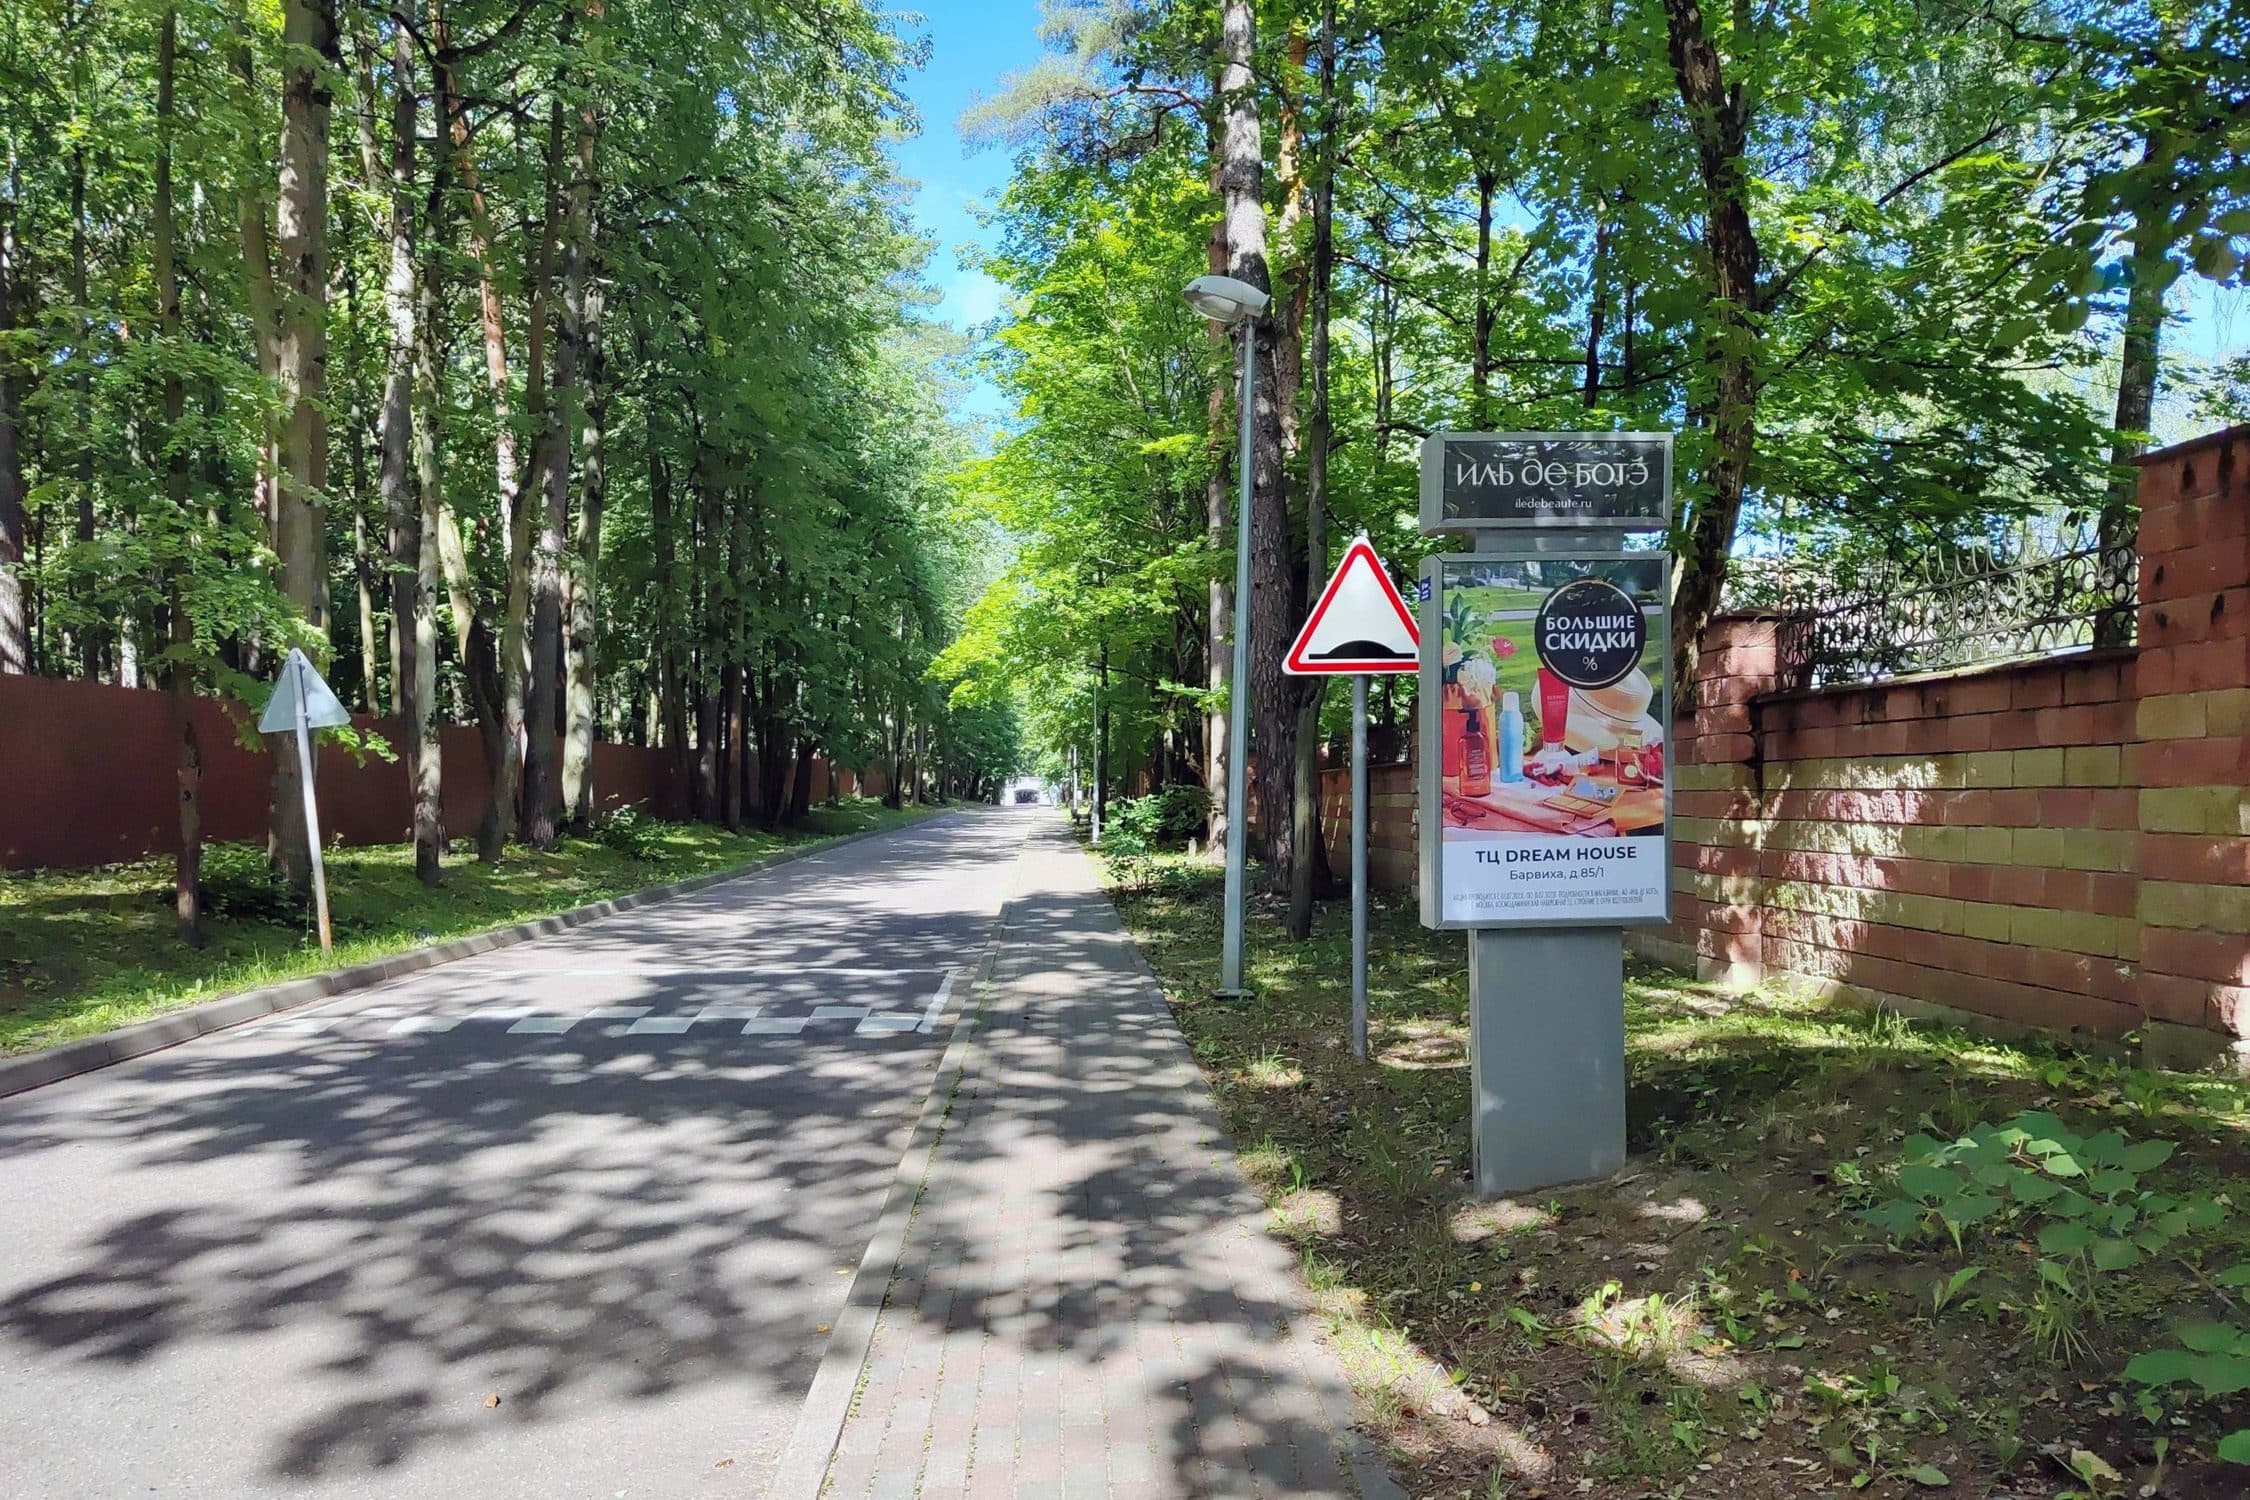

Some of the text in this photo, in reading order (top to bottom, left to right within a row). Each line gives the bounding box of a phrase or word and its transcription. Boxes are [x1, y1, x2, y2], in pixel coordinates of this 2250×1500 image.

[1457, 463, 1514, 486] ИЛЬ
[1576, 462, 1648, 487] БОТЭ
[1515, 498, 1592, 509] iledebeaute.ru
[1546, 615, 1635, 631] БОЛЬШИЕ
[1545, 631, 1636, 652] СКИДКИ
[1582, 656, 1598, 671] %
[1475, 846, 1637, 864] ТЦ DREAM HOUSE
[1510, 869, 1567, 881] Барвиха,
[1580, 867, 1604, 880] 85/1
